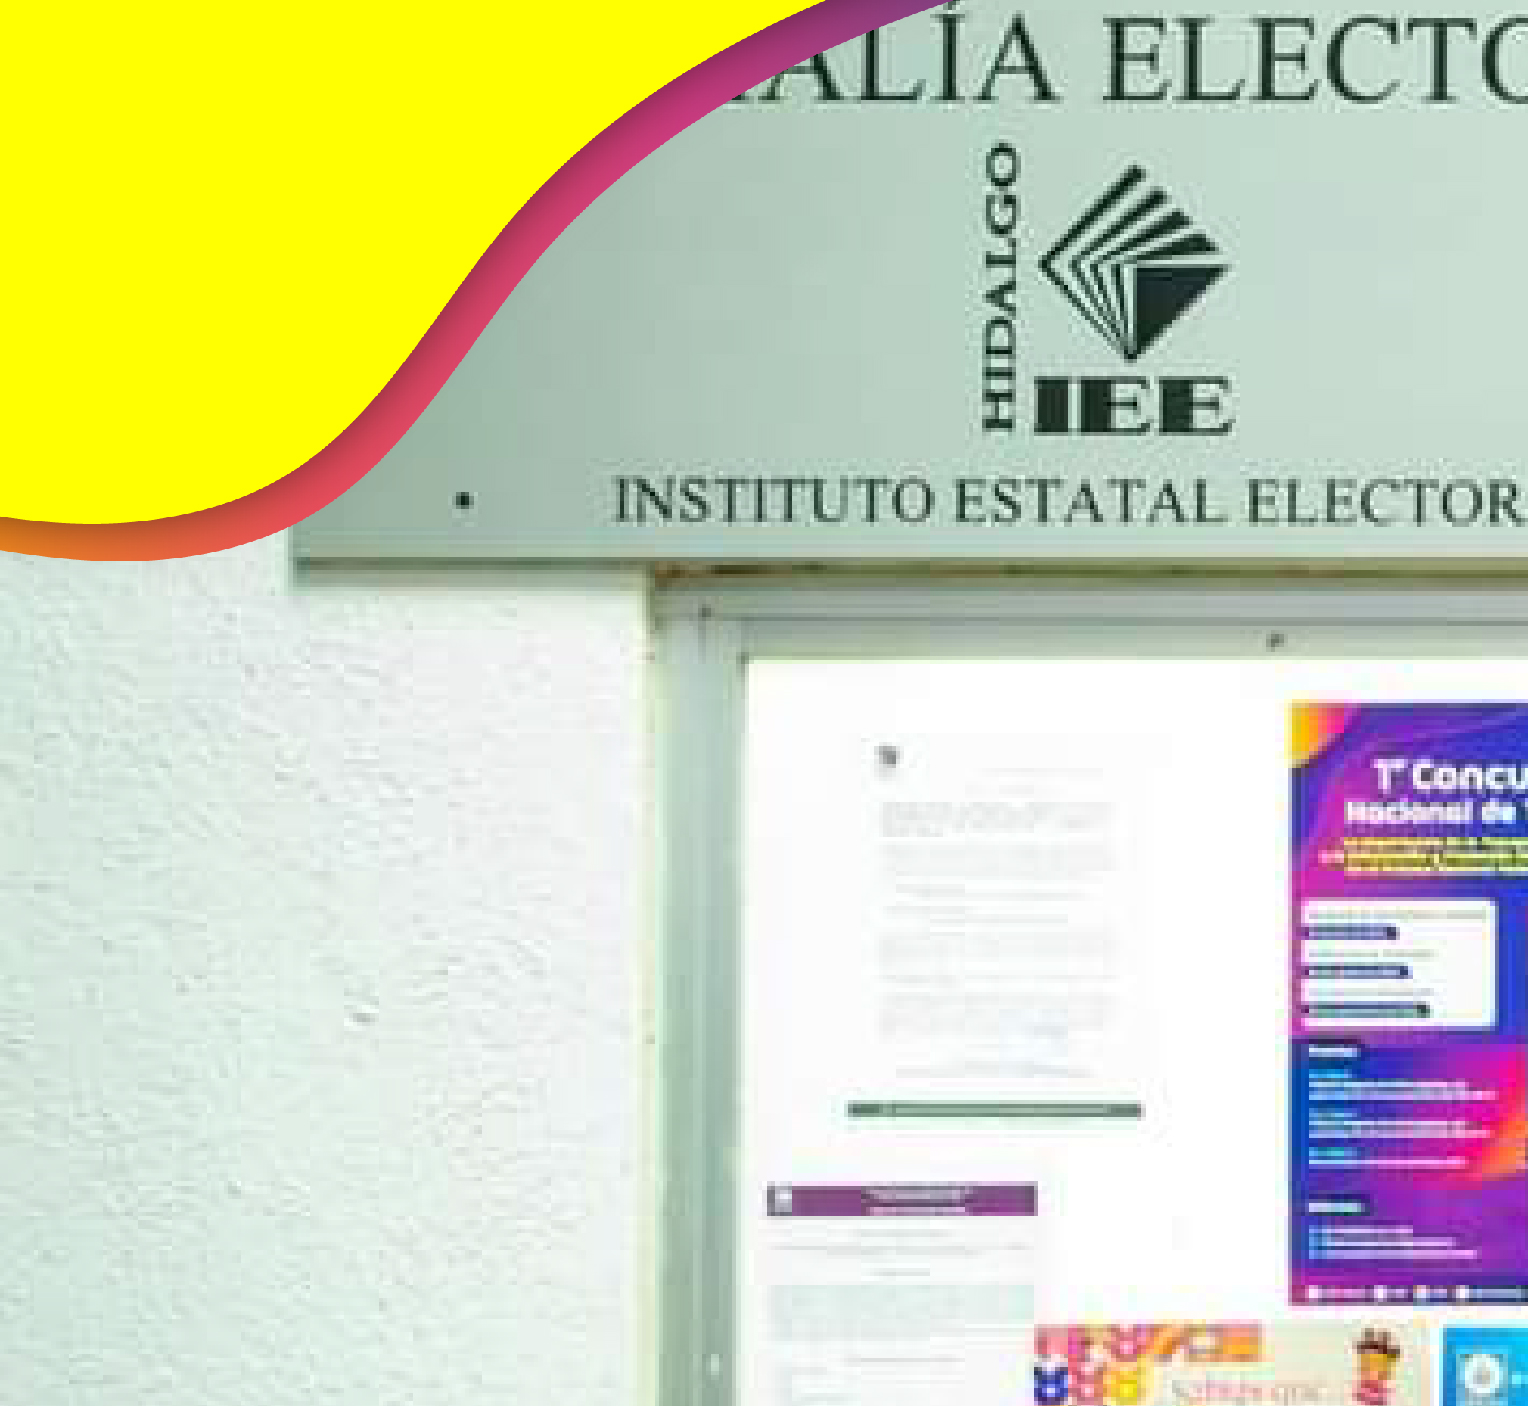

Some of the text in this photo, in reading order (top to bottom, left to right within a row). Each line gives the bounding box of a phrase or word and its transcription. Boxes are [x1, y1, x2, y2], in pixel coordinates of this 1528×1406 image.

[730, 0, 1062, 104] ALÍA
[980, 142, 1018, 435] HIDALGO
[1032, 375, 1234, 435] IEE
[614, 477, 936, 524] INSTITUTO
[954, 478, 1225, 526] ESTATAL
[1344, 798, 1472, 825] Nacional
[1479, 798, 1517, 825] de
